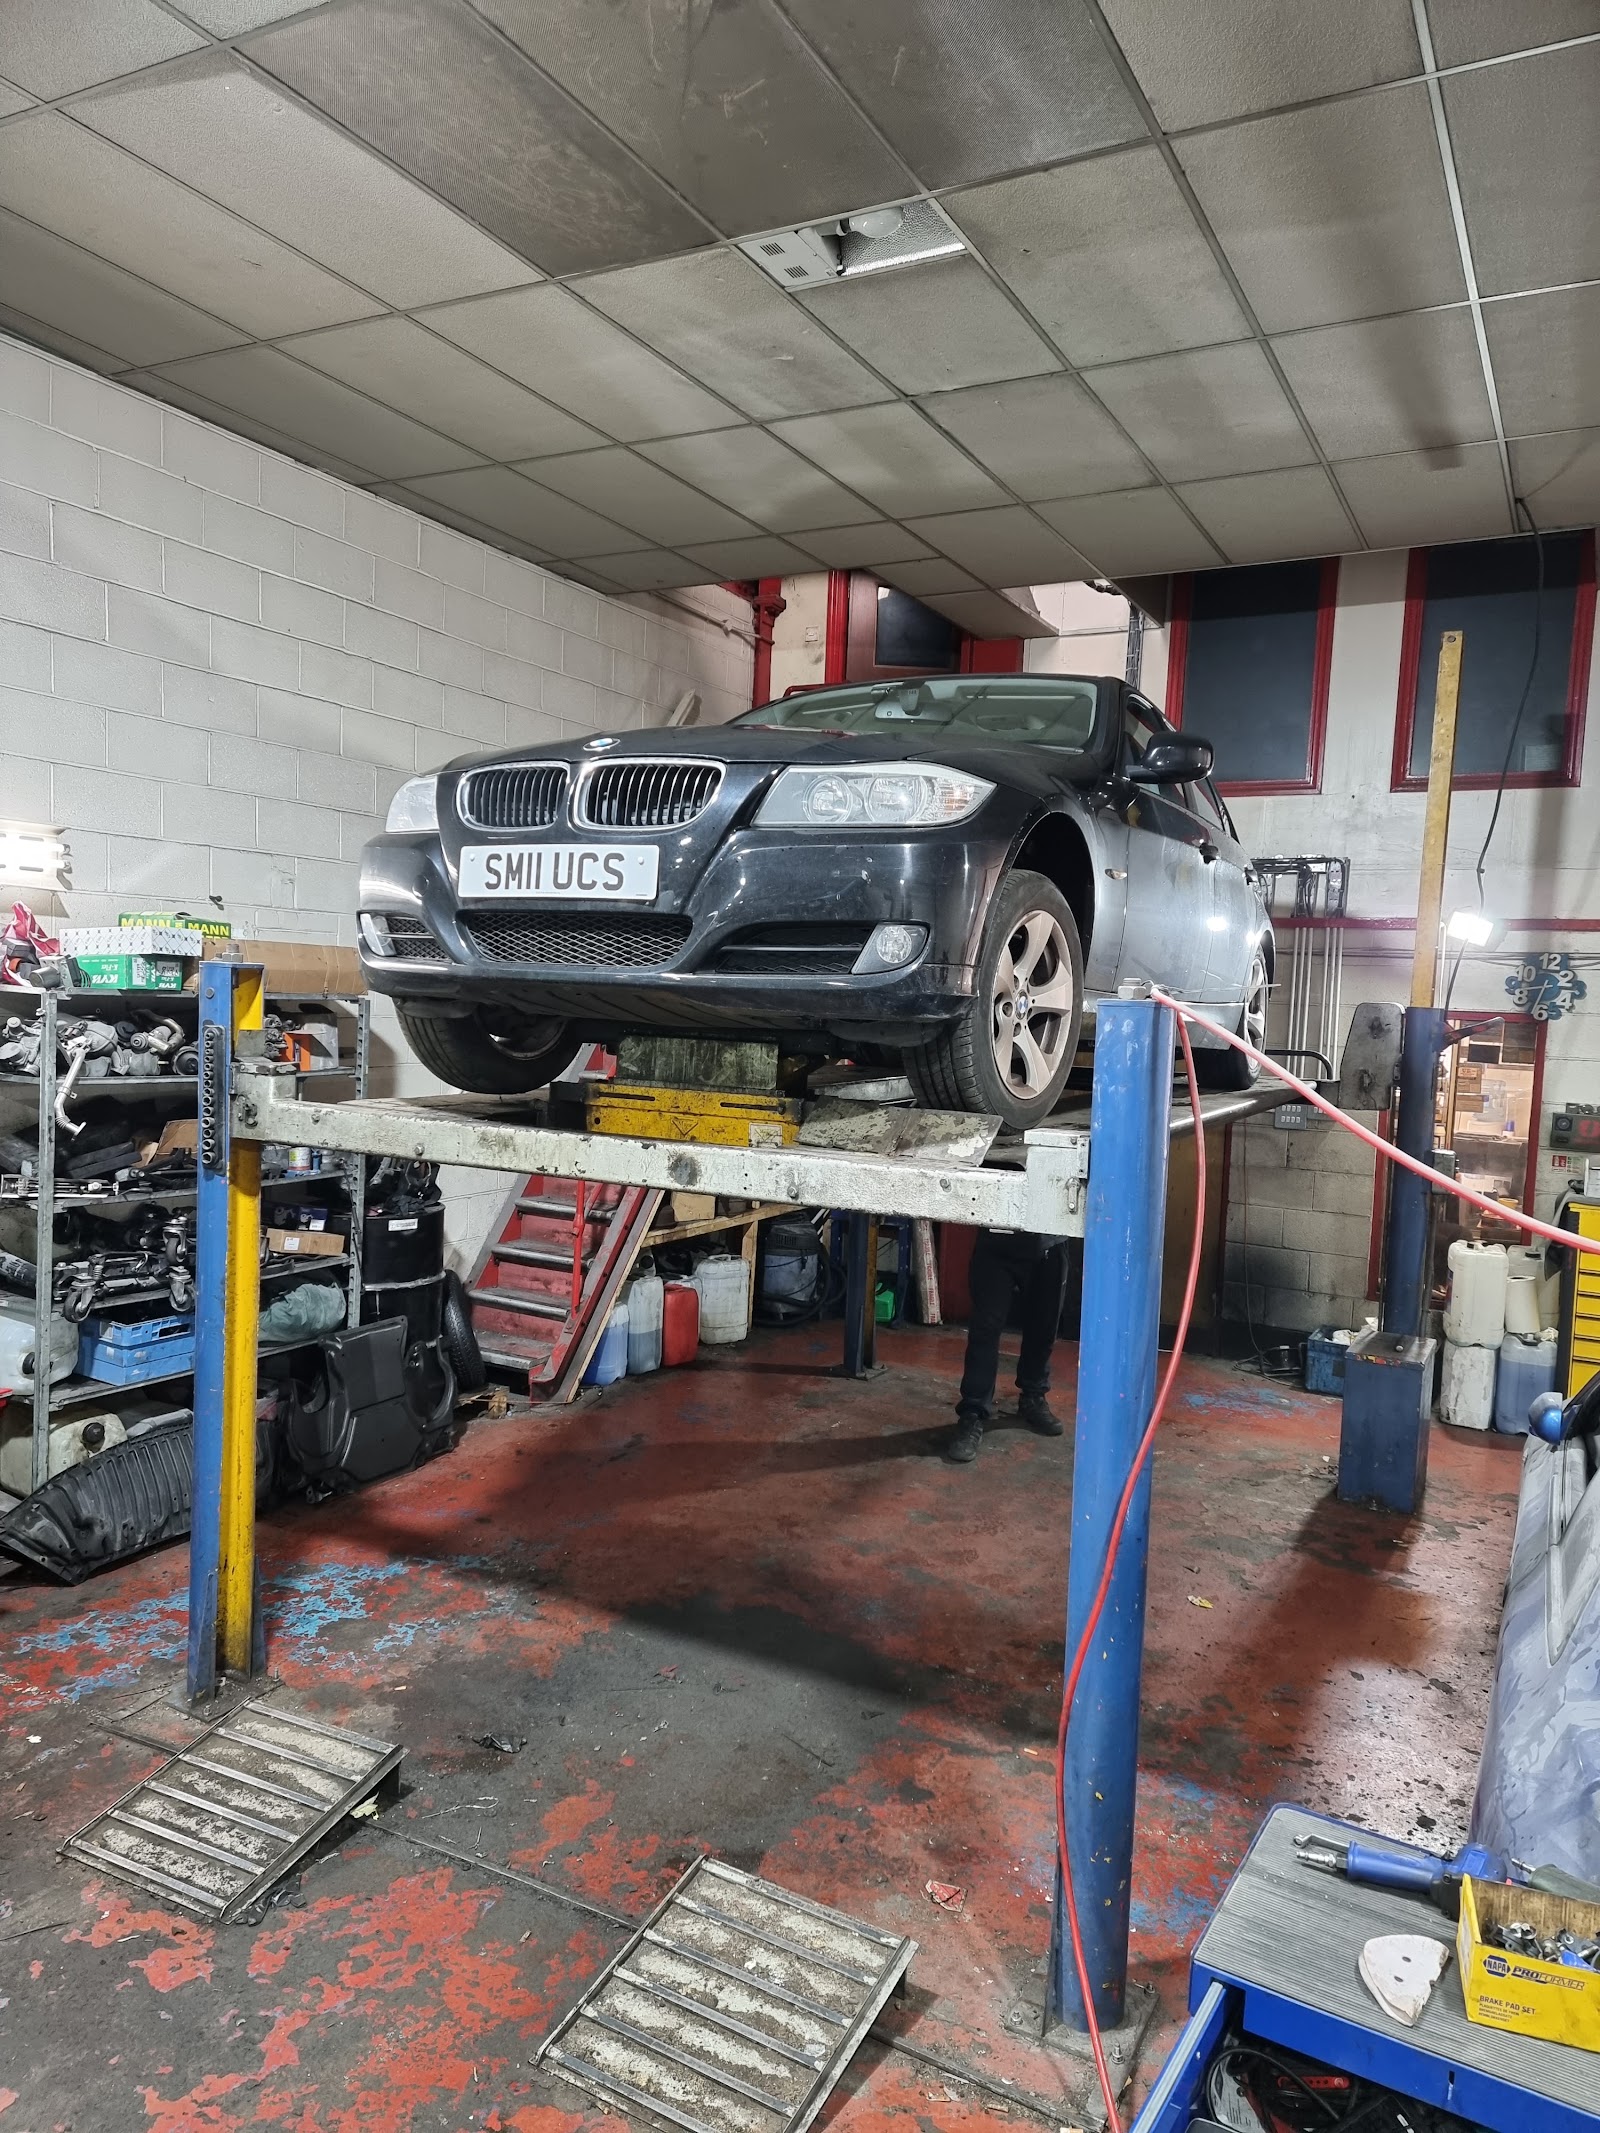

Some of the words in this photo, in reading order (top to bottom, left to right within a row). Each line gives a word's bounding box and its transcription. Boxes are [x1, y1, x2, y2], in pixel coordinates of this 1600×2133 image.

[485, 853, 542, 890] SM11
[552, 852, 625, 891] UCS
[188, 922, 229, 936] MANN
[1540, 953, 1561, 970] 12
[91, 973, 119, 985] KYB
[1516, 964, 1536, 982] 10
[1557, 970, 1574, 987] 2
[1505, 976, 1520, 995] 9
[1513, 988, 1529, 1005] 8
[1555, 990, 1573, 1009] 4
[1533, 1004, 1548, 1020] 6
[1548, 1002, 1562, 1020] 5
[1486, 1959, 1507, 1973] NAPA
[1512, 1966, 1585, 1991] PROFORMER
[1480, 1995, 1503, 2007] BRAKE
[1505, 2001, 1520, 2011] PAD
[1522, 2006, 1536, 2015] SET
